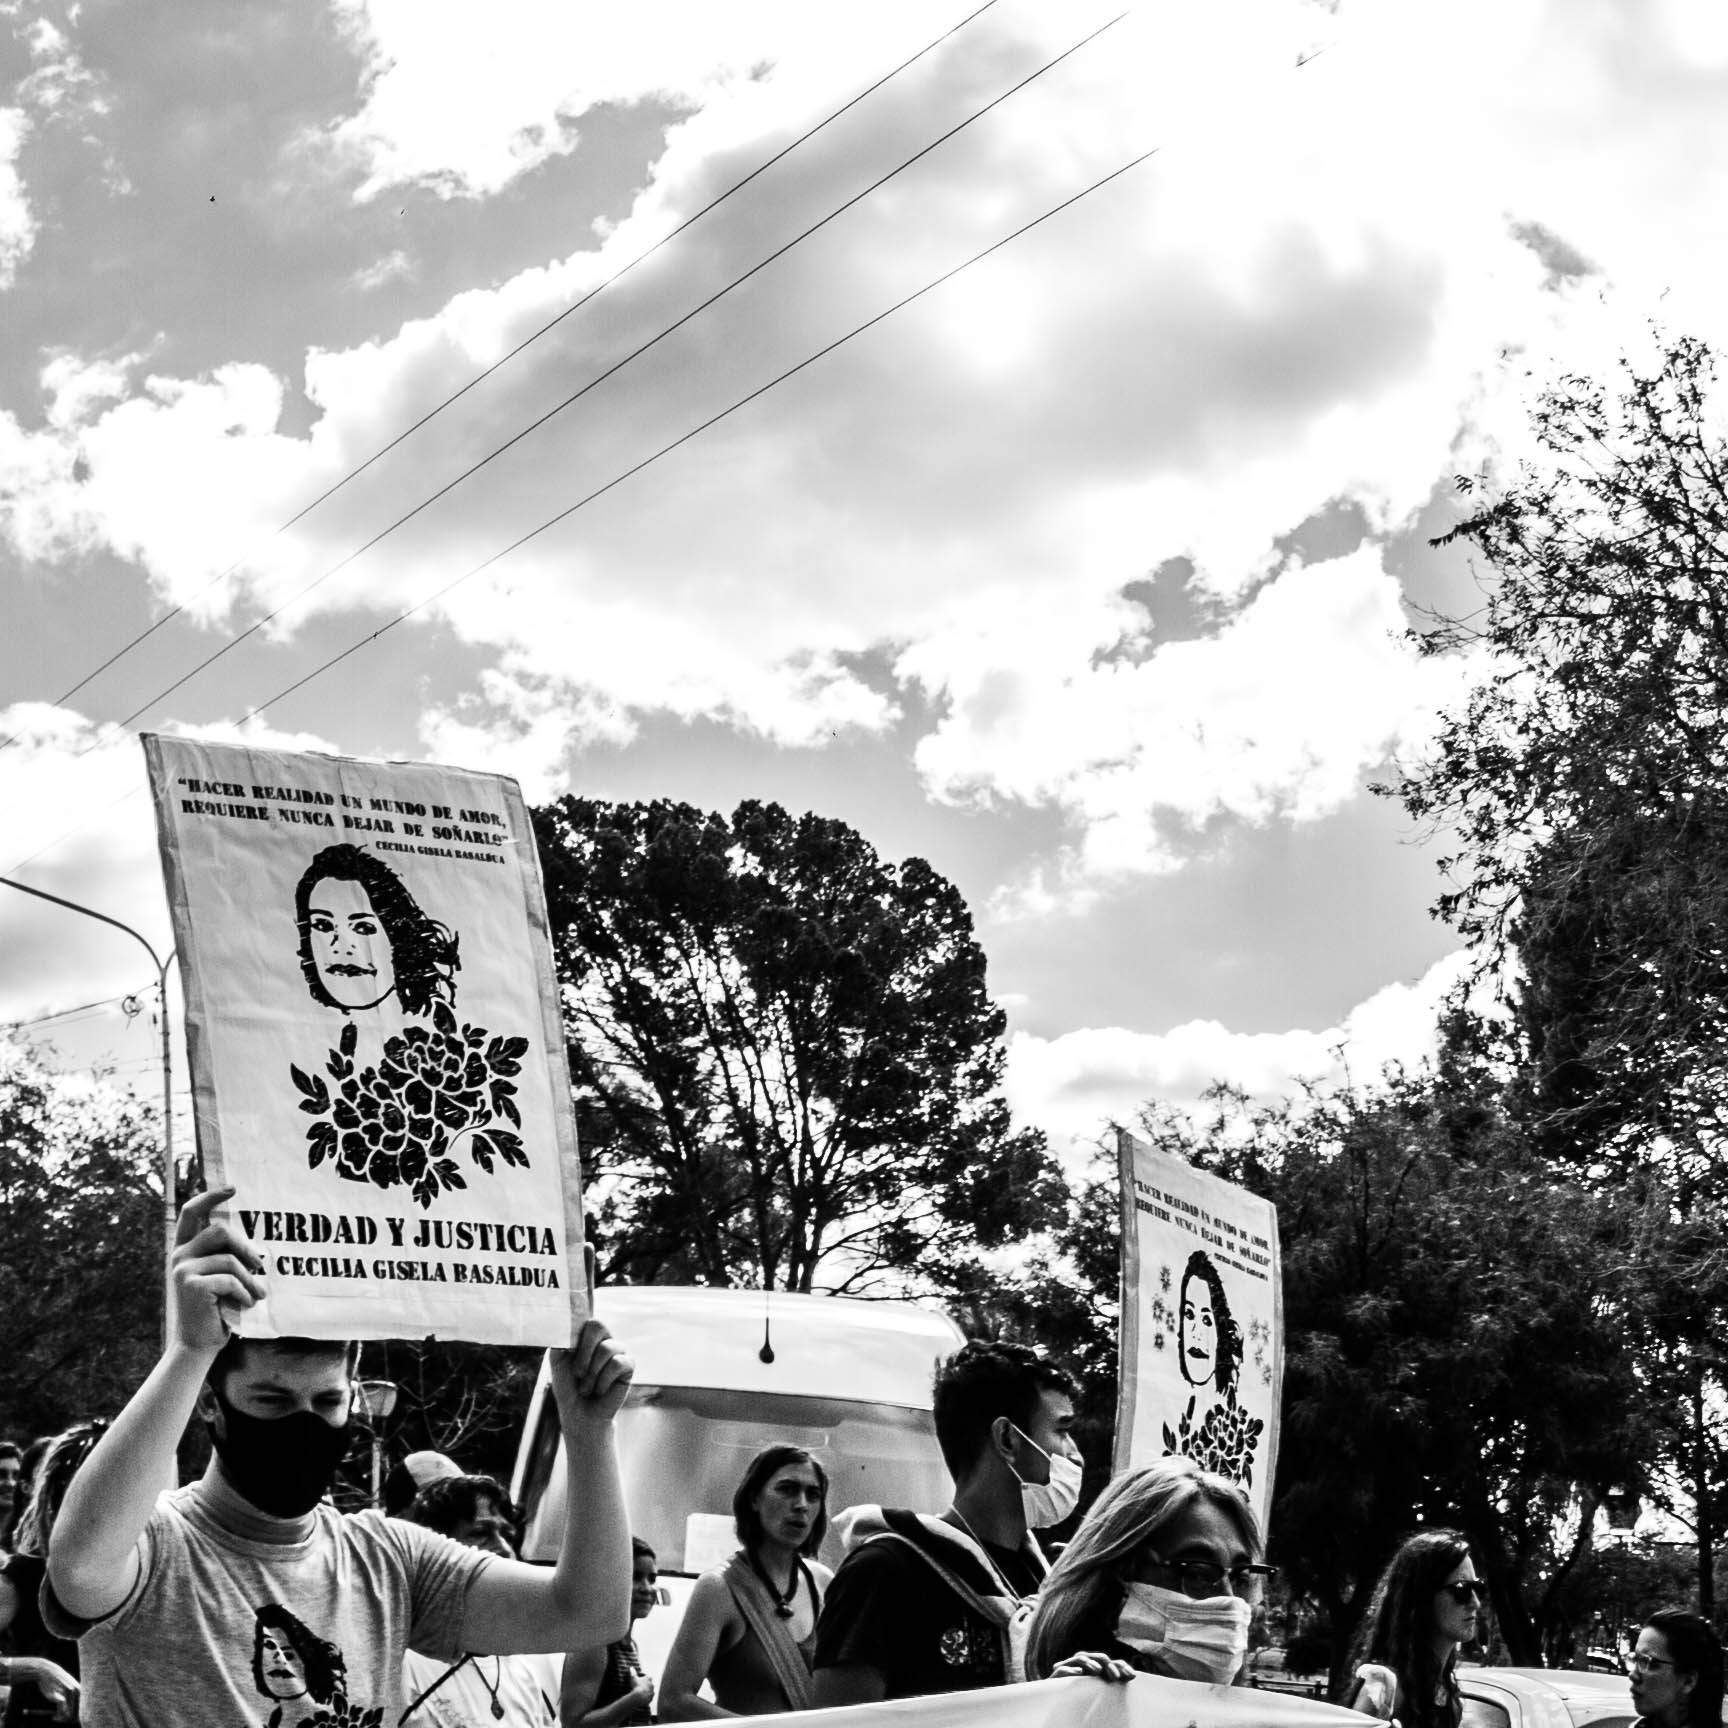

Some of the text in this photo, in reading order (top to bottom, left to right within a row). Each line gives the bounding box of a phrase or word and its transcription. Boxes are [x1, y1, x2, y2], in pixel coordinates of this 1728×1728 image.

[181, 799, 269, 821] REQUIERE
[278, 808, 334, 827] NUNCA
[343, 814, 395, 834] DEJAR
[403, 822, 424, 838] DE
[252, 785, 334, 805] REALIDAD
[340, 794, 362, 810] UN
[370, 798, 426, 817] MUNDO
[432, 805, 453, 820] DE
[459, 808, 506, 829] AMOR,
[375, 840, 505, 865] CECILIA GISELA BASALDUA
[238, 1209, 558, 1256] VERDAD Y JUSTICIA
[276, 1255, 368, 1279] CECILIA
[372, 1259, 448, 1283] GISELA
[453, 1262, 560, 1290] BASALDUA
